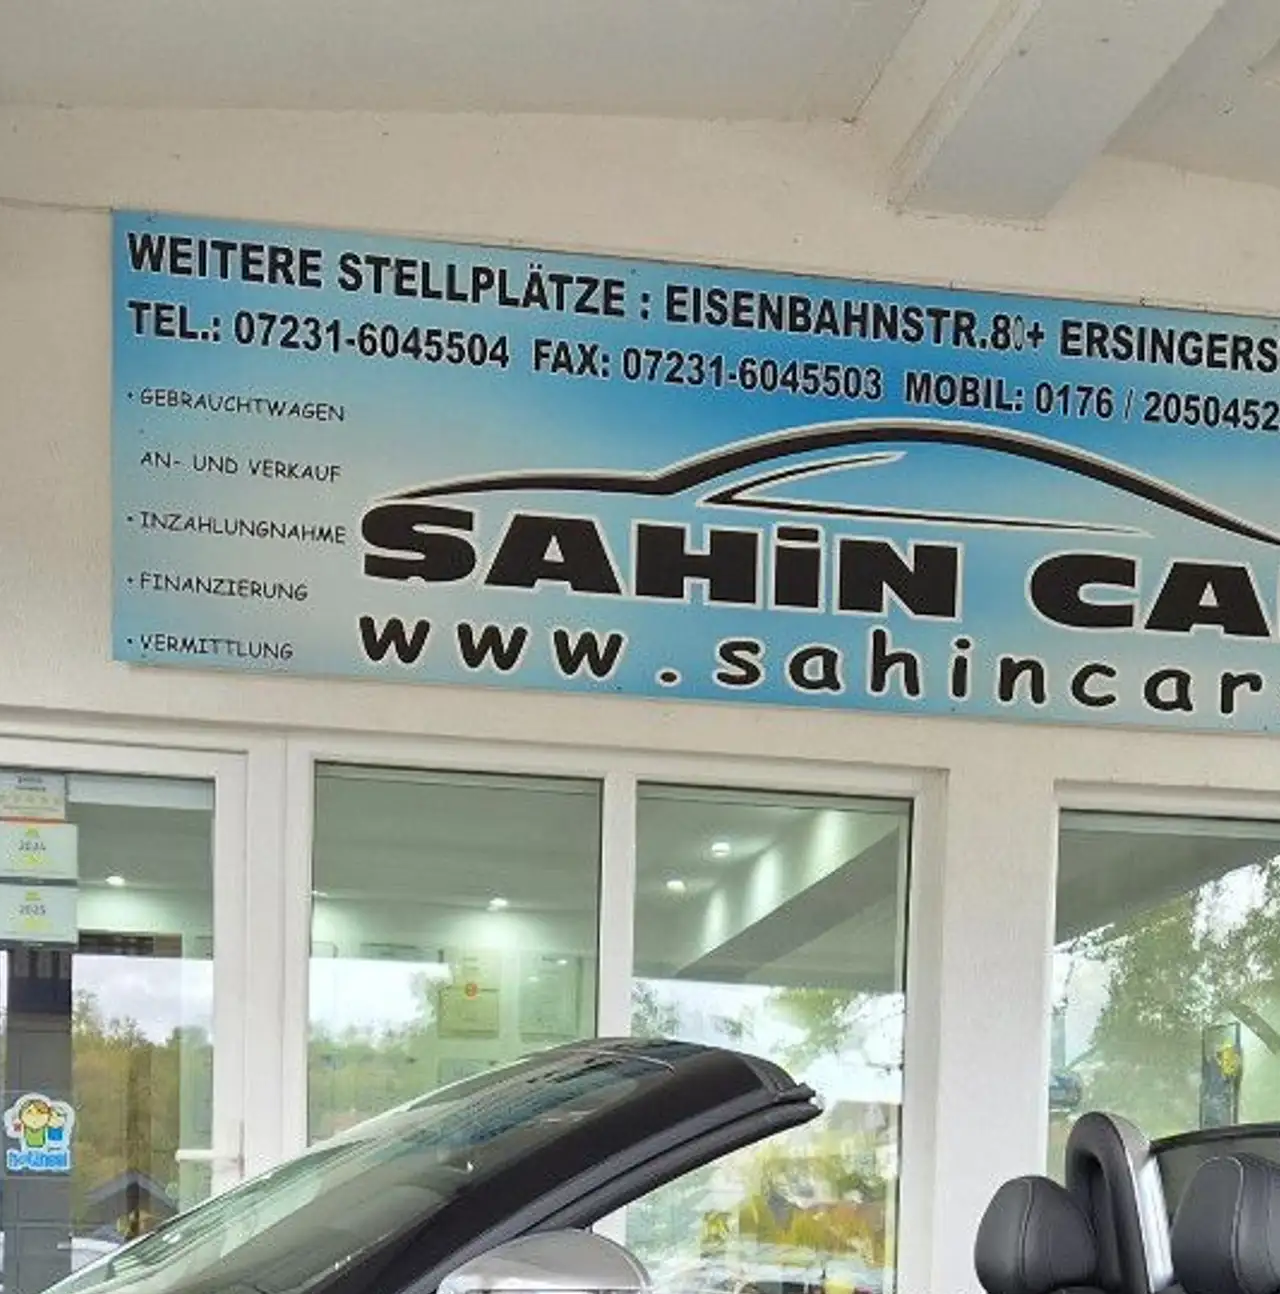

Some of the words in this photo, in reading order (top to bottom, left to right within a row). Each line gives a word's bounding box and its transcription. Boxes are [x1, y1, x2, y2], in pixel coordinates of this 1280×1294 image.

[127, 231, 323, 289] WEITERE
[337, 252, 626, 318] STELLPLÄTZE
[128, 300, 221, 343] TEL.:
[234, 310, 510, 369] 07231-6045504
[533, 338, 610, 378] FAX:
[623, 347, 883, 400] 07231-6045503
[905, 371, 1023, 411] MOBIL:
[1035, 381, 1114, 419] 0176
[140, 388, 345, 422] GEBRAUCHTWAGEN
[140, 452, 181, 469] AN-
[192, 456, 238, 475] UND
[249, 459, 341, 483] VERKAUF
[140, 511, 346, 544] INZAHLUNGNAHME
[140, 572, 308, 601] FINANZIERUNG
[140, 634, 294, 660] VERMITTLUNG
